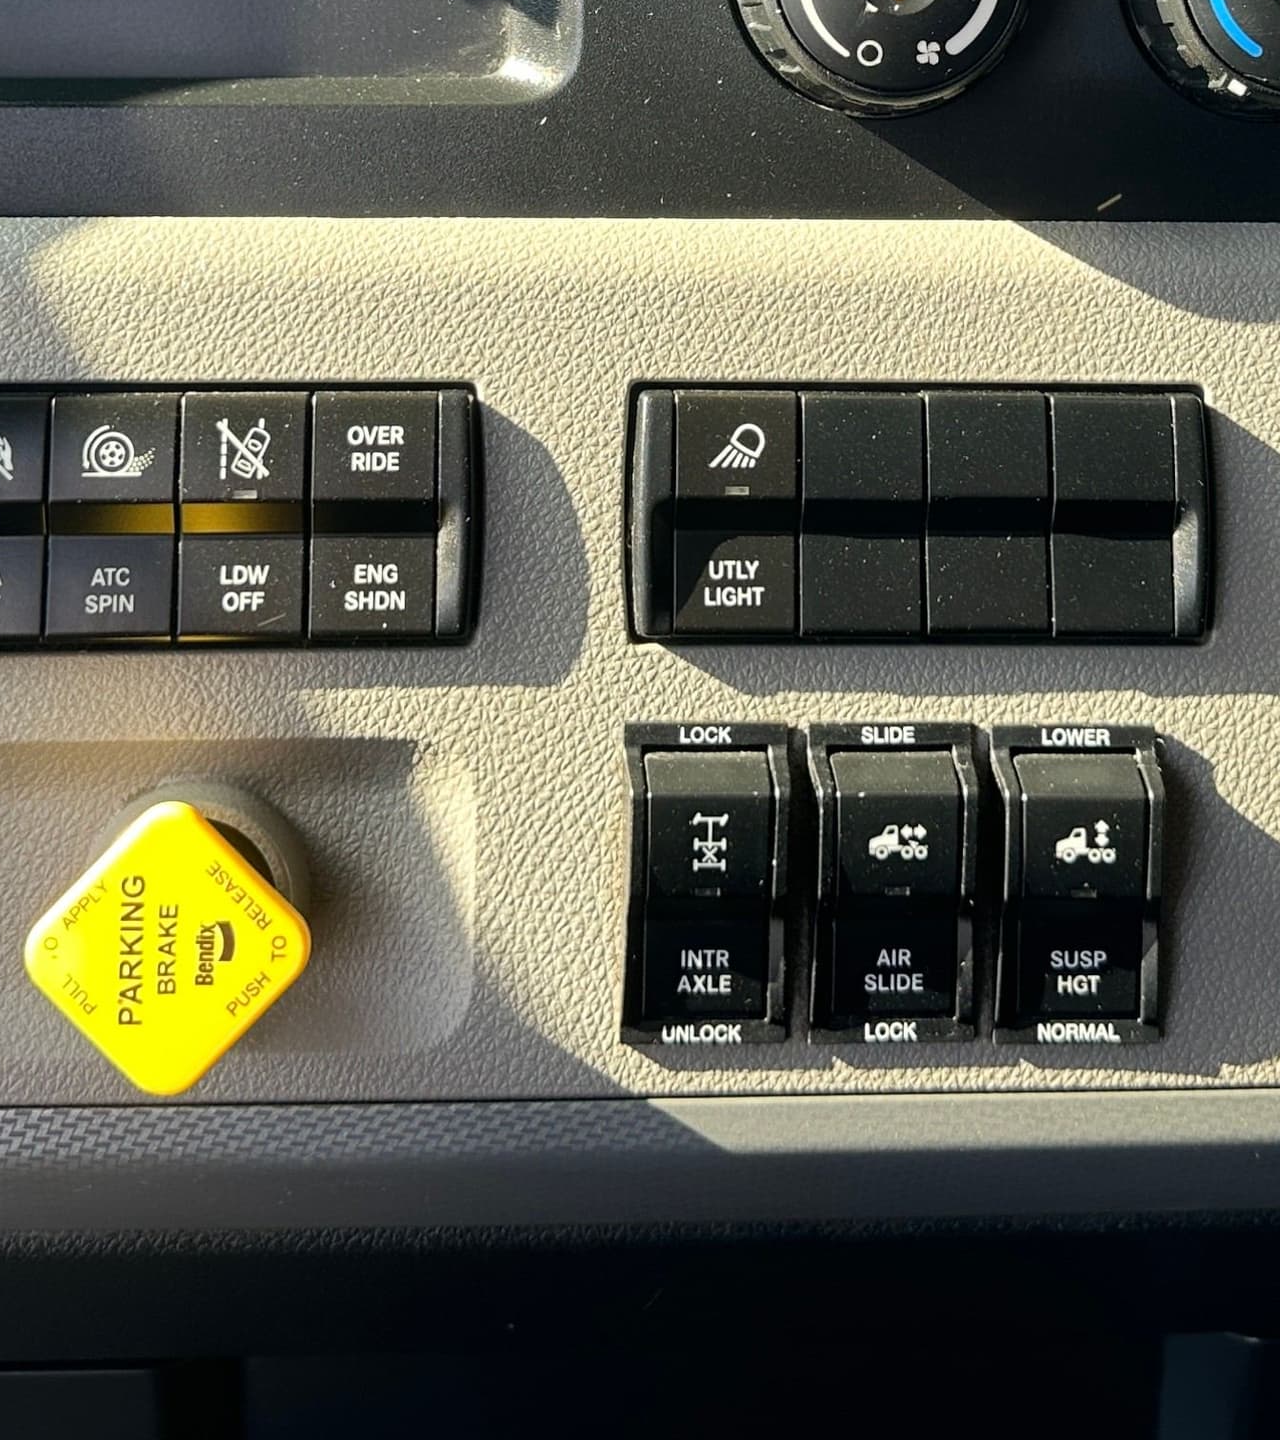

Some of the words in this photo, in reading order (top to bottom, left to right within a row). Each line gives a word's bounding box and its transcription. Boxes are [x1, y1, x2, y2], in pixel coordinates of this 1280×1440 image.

[347, 425, 405, 447] OVER
[351, 451, 400, 473] RIDE
[91, 567, 131, 588] ATC
[220, 564, 270, 586] LDW
[353, 563, 399, 585] ENG
[708, 561, 760, 581] UTLY
[84, 594, 135, 615] SPIN
[222, 590, 265, 612] OFF
[344, 590, 406, 612] SHDN
[704, 586, 765, 607] LIGHT
[679, 726, 733, 746] LOCK
[861, 726, 916, 746] SLIDE
[1041, 728, 1111, 748] LOWER
[62, 879, 108, 931] APPLY
[205, 859, 274, 931] RELEASE
[118, 874, 145, 1026] PARKING
[157, 904, 179, 994] BRAKE
[195, 923, 216, 986] Bendix
[271, 935, 287, 963] TO
[680, 949, 730, 969] INTR
[876, 949, 912, 969] AIR
[1050, 949, 1107, 970] SUSP
[677, 974, 732, 995] AXLE
[864, 972, 924, 992] SLIDE
[1057, 975, 1102, 995] HGT
[62, 973, 98, 1016] PULL
[225, 971, 271, 1016] PUSH
[661, 1024, 742, 1044] UNLOCK
[864, 1022, 918, 1042] LOCK
[1036, 1023, 1121, 1043] NORMAL
